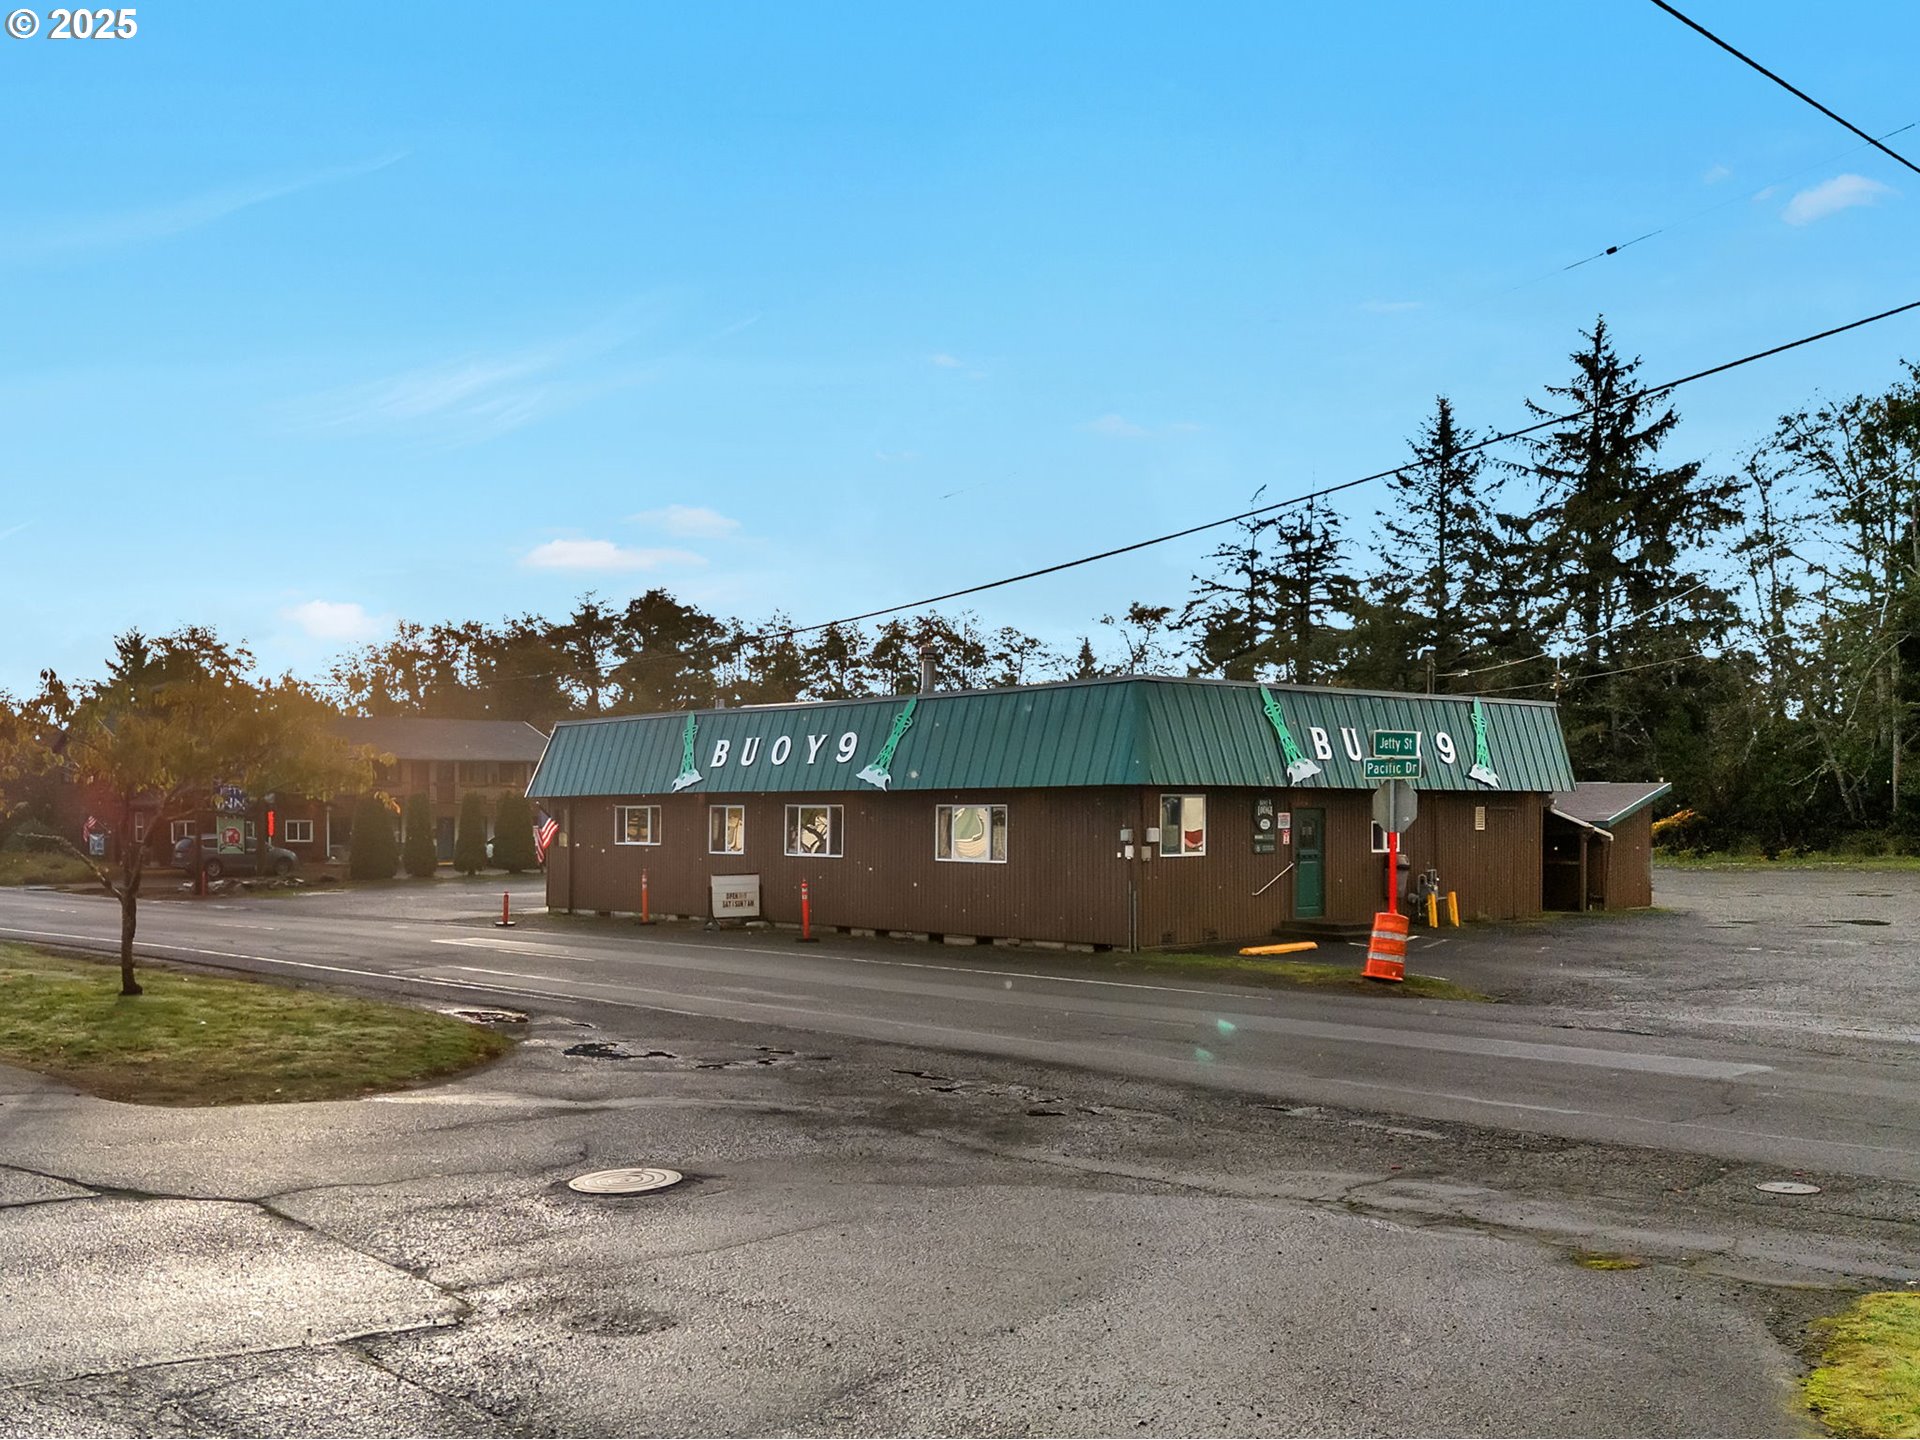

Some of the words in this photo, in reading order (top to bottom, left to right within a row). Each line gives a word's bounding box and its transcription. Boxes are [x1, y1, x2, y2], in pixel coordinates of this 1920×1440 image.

[1380, 737, 1400, 752] Jetty
[1404, 737, 1413, 750] St
[1367, 762, 1401, 774] Pacific
[1405, 761, 1417, 773] Dr
